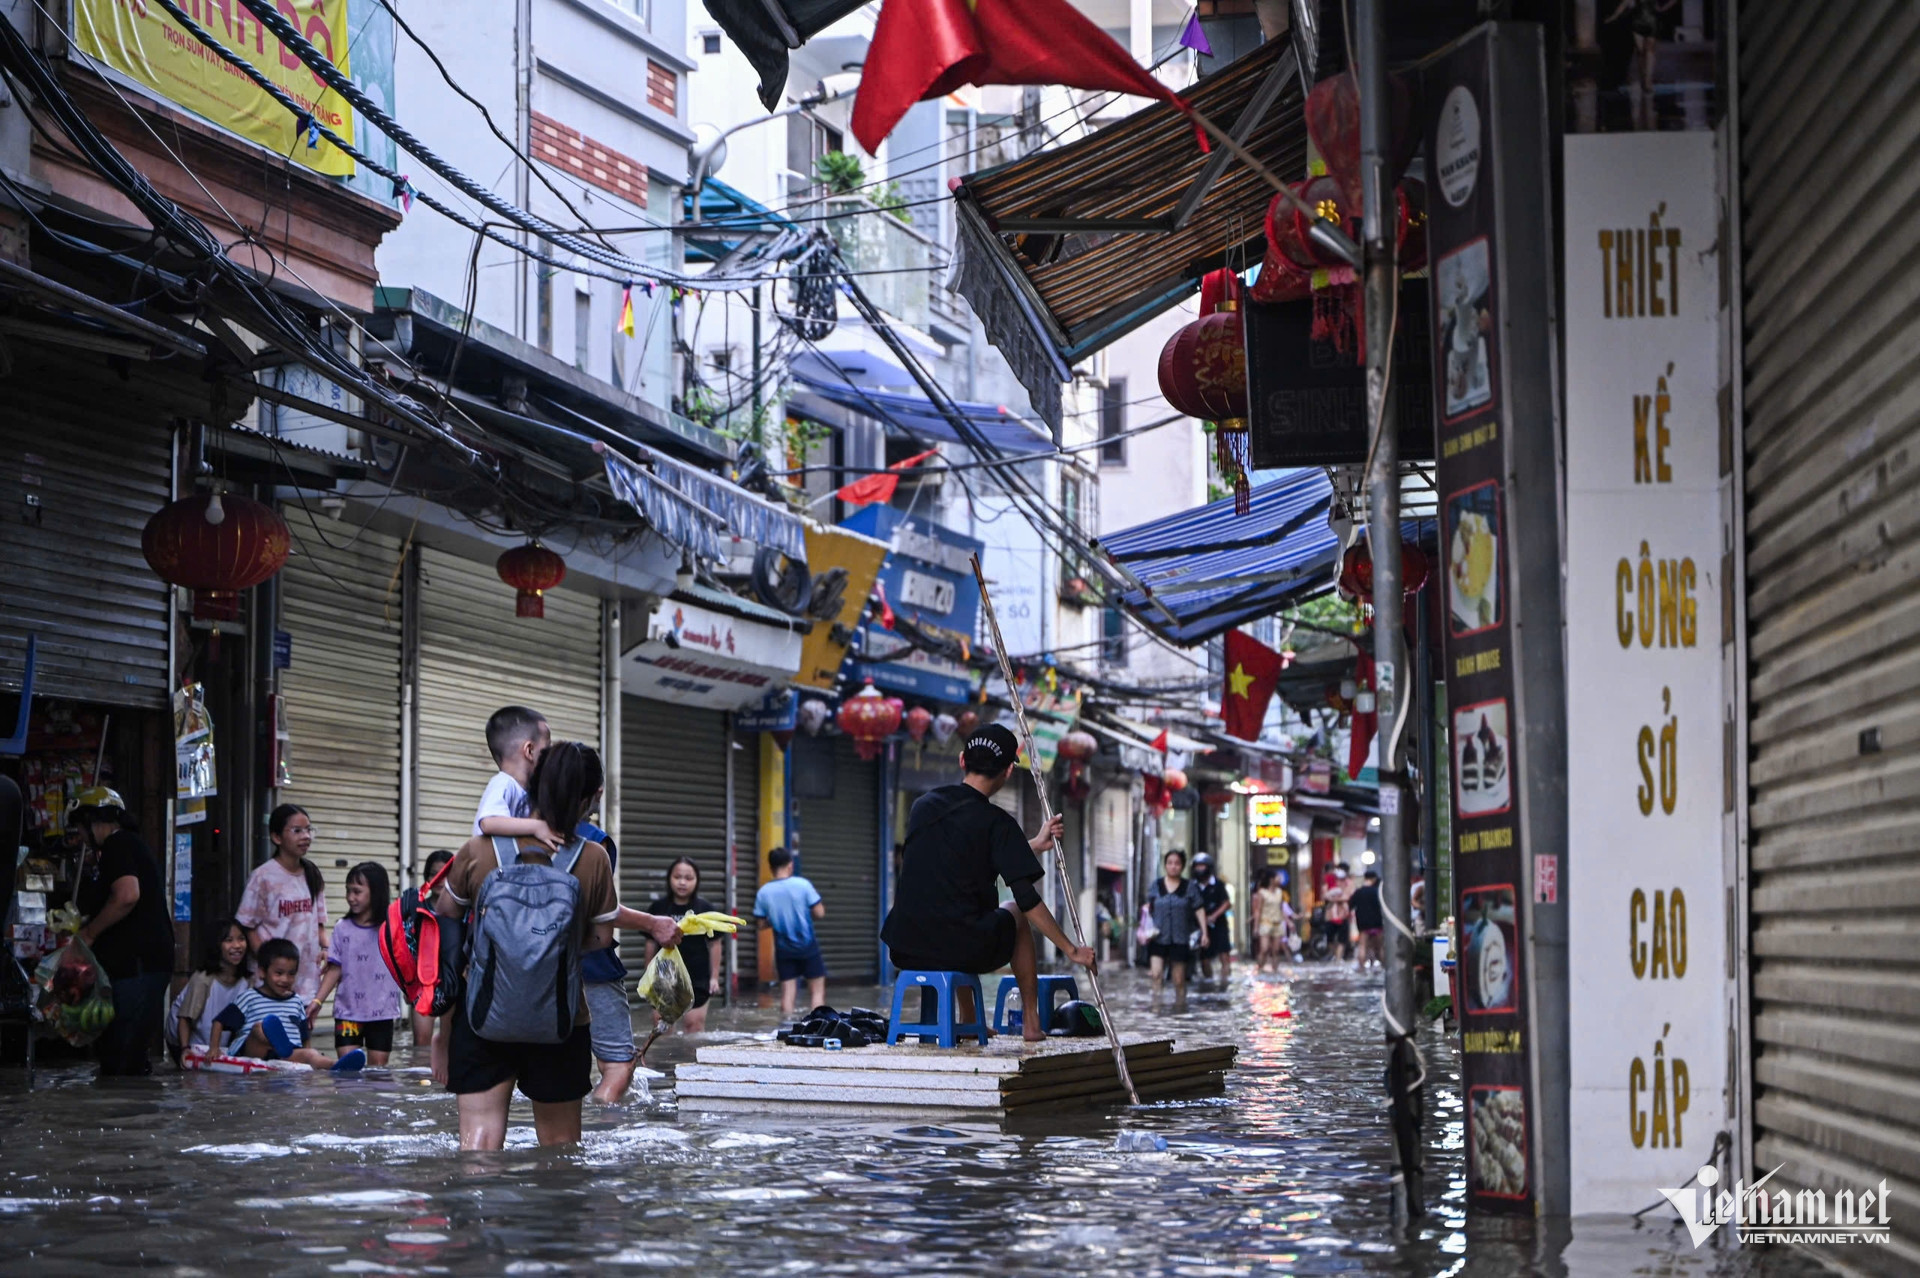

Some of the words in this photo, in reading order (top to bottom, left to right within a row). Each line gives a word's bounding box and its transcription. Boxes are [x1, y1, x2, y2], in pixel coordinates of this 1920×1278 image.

[1598, 202, 1682, 318] THIẾT
[1633, 362, 1675, 484] KẾ
[1615, 539, 1697, 649] CÔNG
[1629, 888, 1688, 980] CAO
[1629, 1023, 1690, 1149] CẤP
